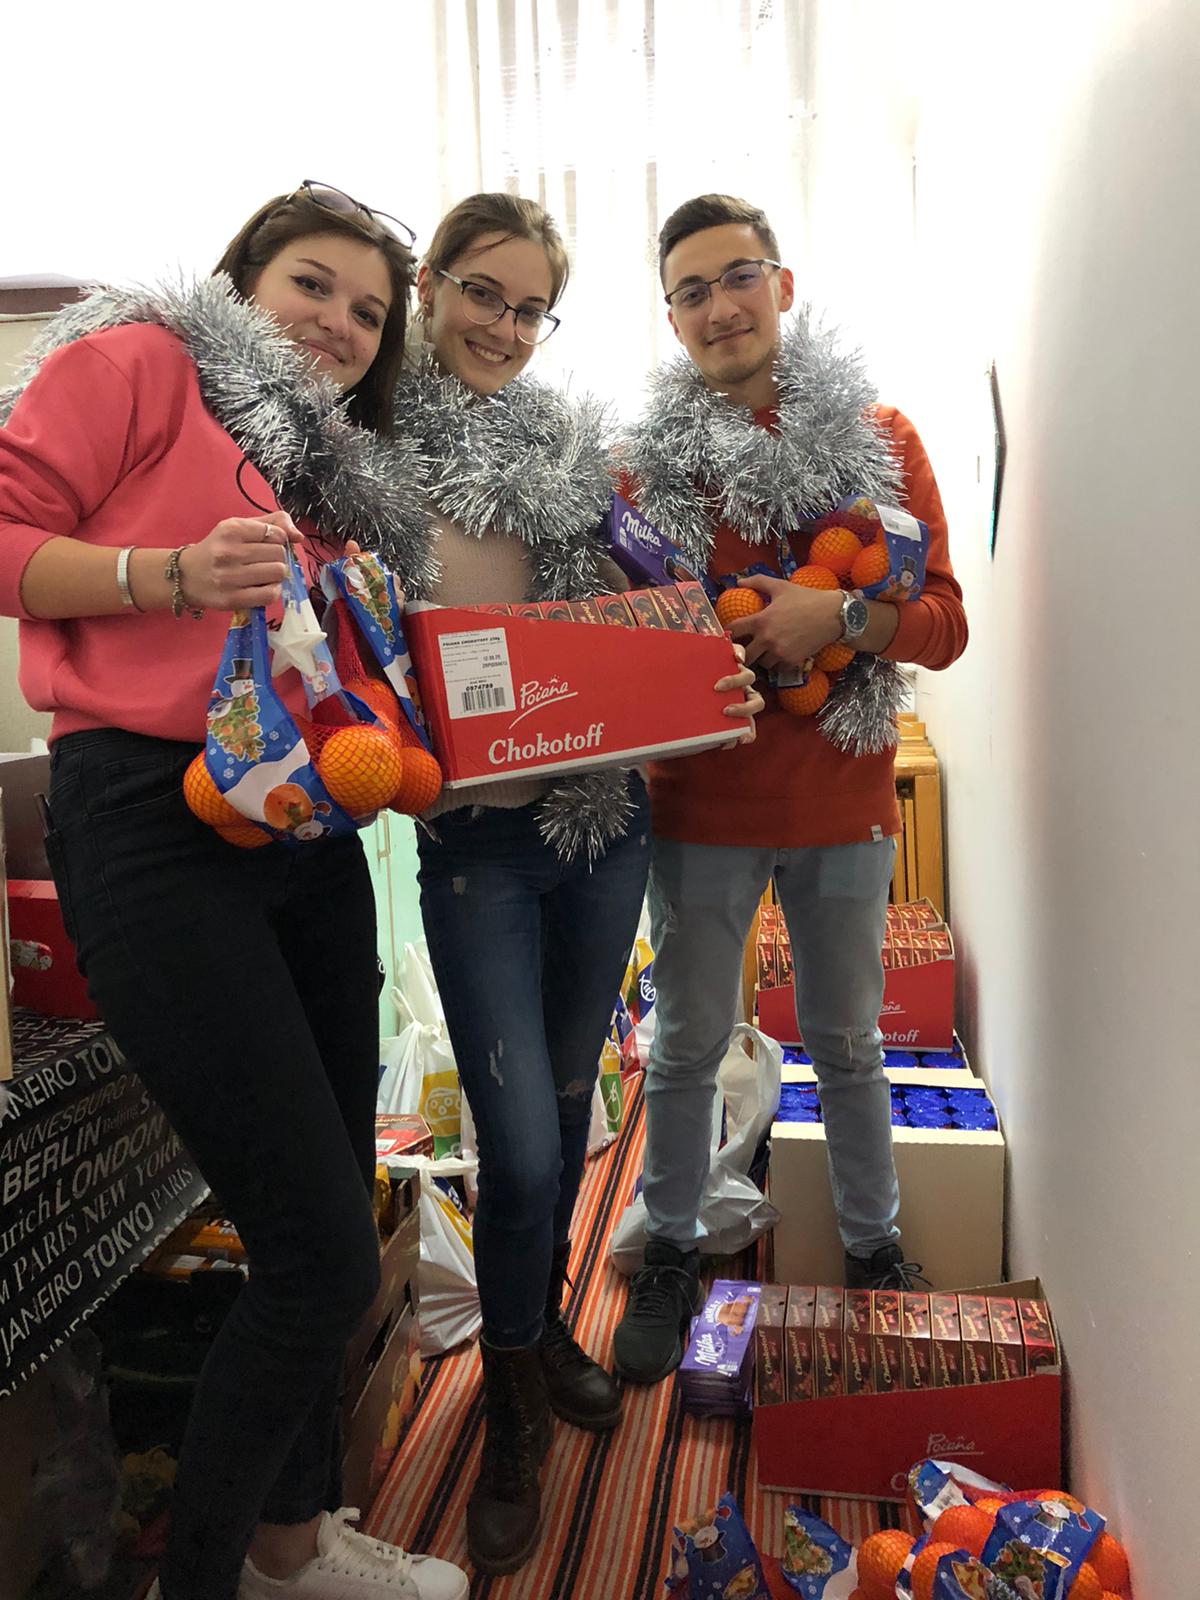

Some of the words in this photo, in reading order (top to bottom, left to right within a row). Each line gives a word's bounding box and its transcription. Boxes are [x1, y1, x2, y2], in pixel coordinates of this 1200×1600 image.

[622, 511, 662, 547] Milka
[518, 674, 570, 711] Poiana
[488, 722, 605, 765] Chokotoff
[2, 1116, 102, 1206] BERLIN
[54, 1112, 165, 1216] LONDON
[13, 1213, 78, 1292] PARIS
[82, 1173, 128, 1233] NEW
[0, 1260, 83, 1368] JANEIRO
[82, 1201, 154, 1279] TOKYO
[150, 1164, 194, 1211] PARIS
[694, 1333, 719, 1366] Milka
